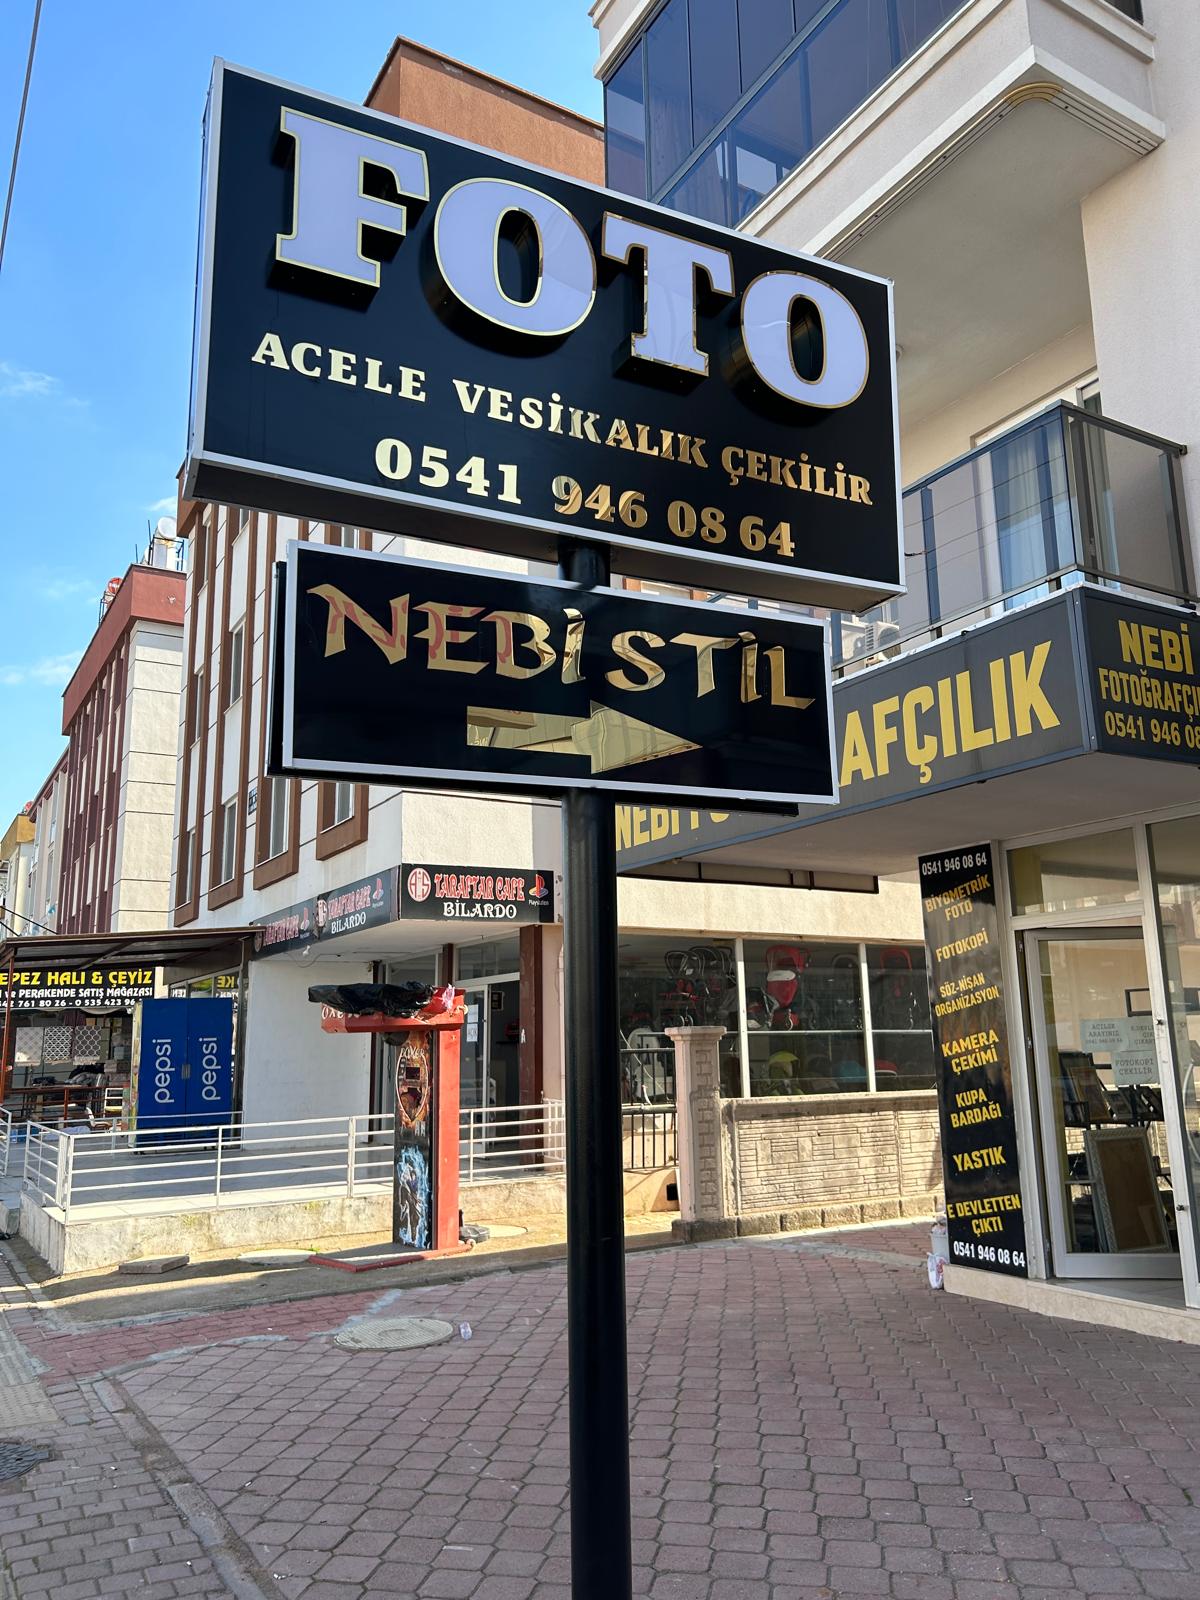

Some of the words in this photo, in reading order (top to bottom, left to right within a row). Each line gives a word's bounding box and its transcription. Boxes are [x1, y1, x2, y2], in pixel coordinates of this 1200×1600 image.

[275, 105, 870, 408] FOTO
[251, 332, 427, 402] ACELE
[452, 379, 709, 468] VESİKALIK
[721, 446, 873, 505] ÇEKİLİR
[375, 438, 522, 504] 0541
[551, 474, 648, 528] 946
[667, 500, 727, 544] 08
[739, 515, 795, 557] 64
[306, 583, 586, 684] NEBİ
[605, 630, 817, 710] STİL
[1118, 619, 1194, 675] NEBİ
[1105, 711, 1145, 741] 0541
[1150, 718, 1181, 747] 946
[921, 861, 942, 876] 0541
[944, 857, 961, 873] 946
[962, 854, 974, 869] 08
[975, 852, 987, 867] 64
[496, 877, 525, 901] CAFE
[925, 874, 991, 913] BİYOMETRİK
[331, 911, 366, 934] BİLARDO
[443, 899, 517, 919] BİLARDO
[944, 899, 974, 921] FOTO
[935, 927, 989, 962] FOTOKOPİ
[47, 971, 86, 986] HALI
[91, 971, 103, 985] &
[108, 968, 153, 987] ÇEYİZ
[939, 971, 985, 998] SÖZ-NİŞAN
[18, 988, 76, 999] PERAKENDE
[79, 987, 104, 999] SATIŞ
[106, 986, 153, 998] MAĞAZASI
[18, 1000, 35, 1008] 761
[55, 999, 67, 1007] 26
[75, 999, 81, 1007] 0
[84, 999, 101, 1007] 535
[104, 998, 121, 1006] 423
[934, 985, 999, 1017] ORGANİZASYON
[941, 1029, 999, 1058] KAMERA
[152, 1038, 175, 1104] pepsi
[199, 1037, 221, 1101] pepsi
[951, 1046, 998, 1075] ÇEKİMİ
[955, 1088, 988, 1109] KUPA
[950, 1100, 1002, 1129] BARDAĞI
[953, 1146, 1007, 1172] YASTIK
[947, 1203, 955, 1218] E
[956, 1194, 1021, 1218] DEVLETTEN
[971, 1216, 1003, 1238] ÇIKTI
[953, 1240, 976, 1258] 0541
[978, 1243, 995, 1262] 946
[997, 1247, 1010, 1265] 08
[1012, 1250, 1025, 1267] 64
